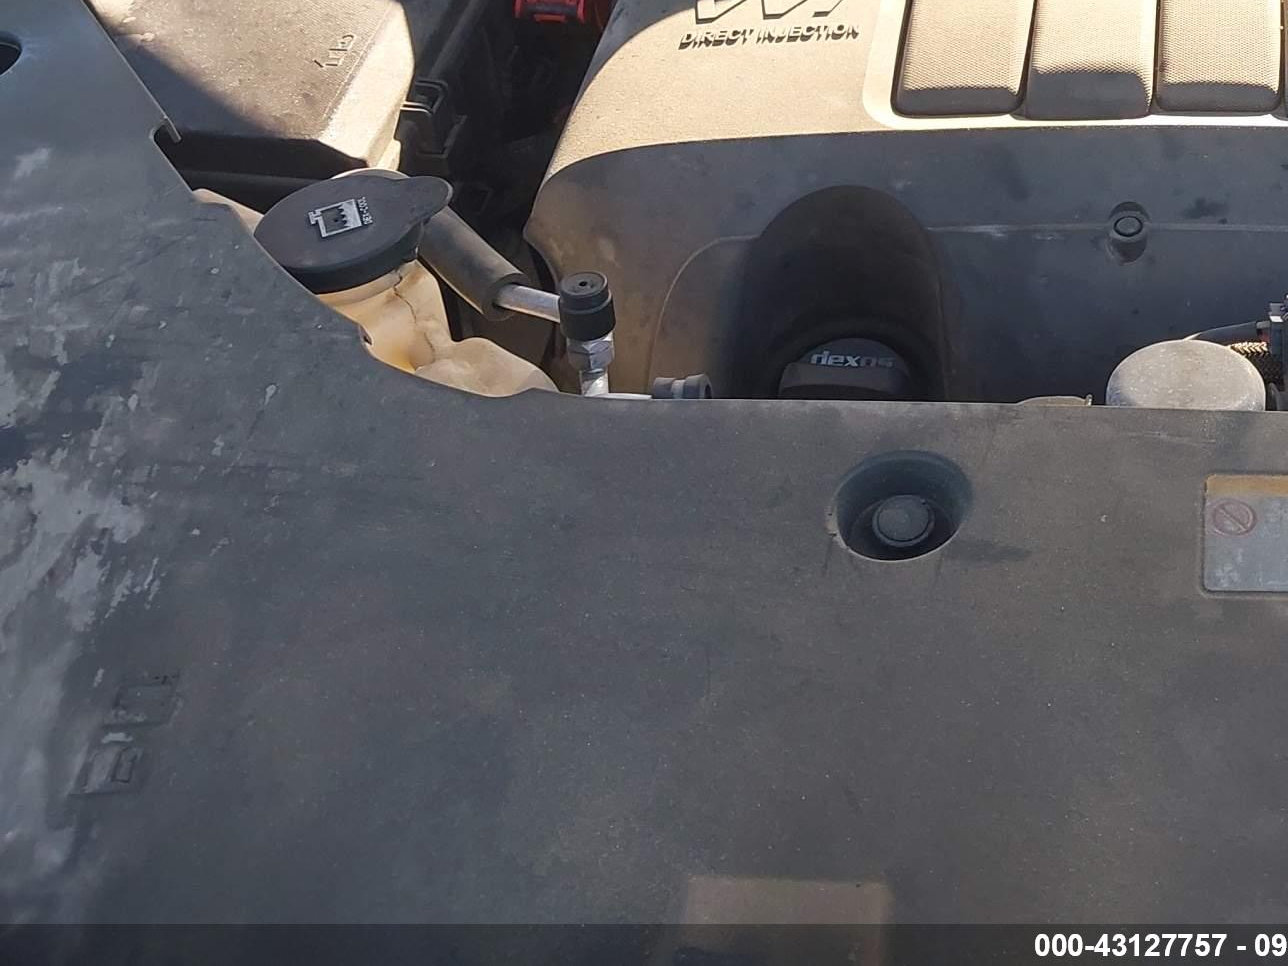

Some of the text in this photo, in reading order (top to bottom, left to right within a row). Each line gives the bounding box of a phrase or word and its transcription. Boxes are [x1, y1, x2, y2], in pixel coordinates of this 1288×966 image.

[678, 23, 861, 50] DIRECT INJECTION
[810, 350, 896, 369] dexos
